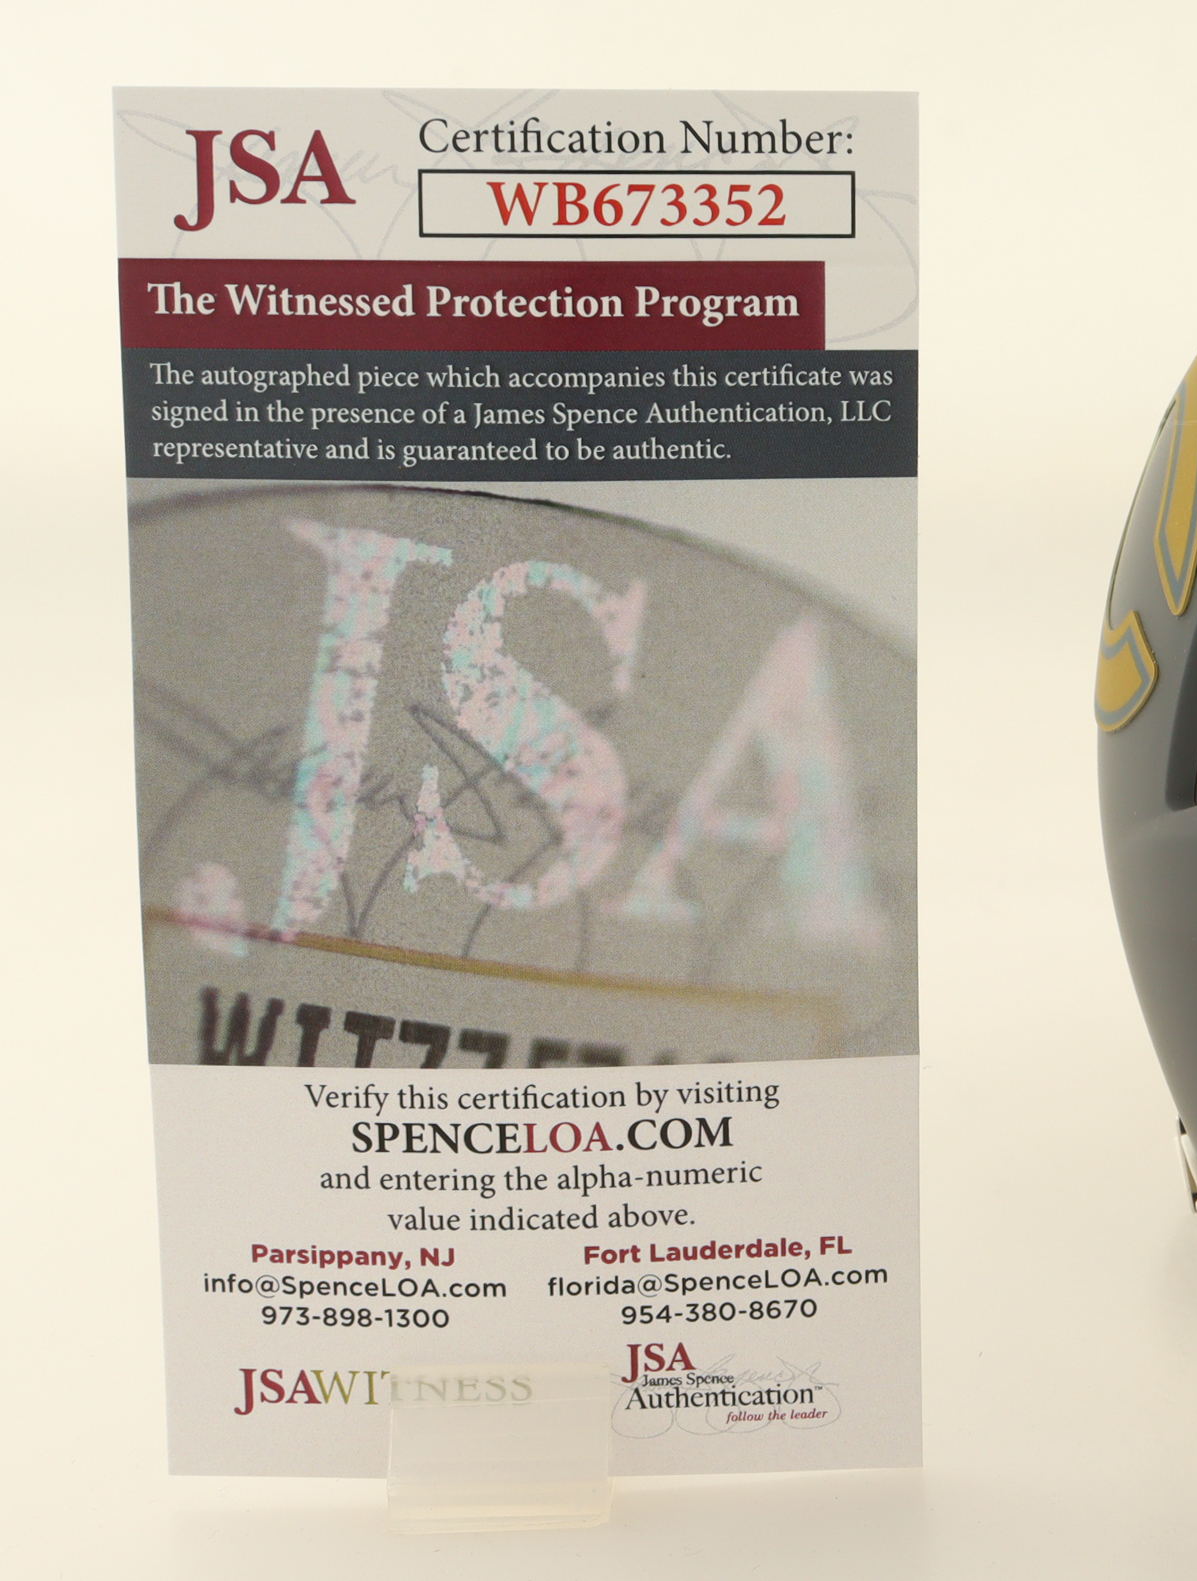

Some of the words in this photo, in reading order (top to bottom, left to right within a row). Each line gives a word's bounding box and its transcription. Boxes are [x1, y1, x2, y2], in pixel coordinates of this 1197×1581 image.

[419, 117, 666, 153] Certification
[680, 119, 855, 154] Number:
[174, 129, 356, 231] JSA
[486, 182, 786, 226] WB673352
[147, 282, 215, 315] The
[224, 284, 415, 316] Witnessed
[426, 286, 624, 317] Protection
[635, 286, 799, 327] Program
[150, 362, 194, 385] The
[201, 364, 350, 393] autographed
[358, 366, 419, 394] piece
[426, 365, 500, 387] which
[509, 366, 665, 394] accompanies
[673, 364, 717, 387] this
[725, 363, 841, 386] certificate
[849, 371, 893, 385] was
[152, 399, 228, 428] signed
[236, 401, 260, 422] in
[266, 400, 304, 422] the
[311, 408, 415, 430] presence
[422, 401, 449, 424] of
[454, 409, 466, 424] a
[474, 403, 545, 428] James
[553, 402, 638, 431] Spence
[645, 401, 832, 425] Authentication,
[841, 400, 891, 421] LLC
[153, 438, 318, 464] representative
[326, 437, 370, 459] and
[377, 439, 395, 460] is
[403, 438, 538, 467] guaranteed
[545, 442, 569, 460] to
[577, 438, 605, 460] be
[613, 437, 731, 459] authentic.
[172, 519, 891, 959] JSA
[304, 1084, 389, 1116] Verify
[397, 1085, 448, 1109] this
[458, 1084, 626, 1109] certification
[635, 1082, 669, 1113] by
[677, 1081, 779, 1108] visiting
[353, 1117, 733, 1154] SPENCELOA.COM
[321, 1165, 370, 1189] and
[380, 1169, 495, 1199] entering
[504, 1166, 547, 1191] the
[558, 1161, 762, 1197] alpha-numeric
[388, 1206, 460, 1231] value
[470, 1205, 598, 1231] indicated
[609, 1203, 695, 1228] above.
[252, 1244, 411, 1270] Parsippany,
[420, 1248, 454, 1266] NJ
[584, 1245, 641, 1265] Fort
[650, 1238, 810, 1262] Lauderdale,
[820, 1236, 852, 1255] FL
[204, 1273, 506, 1299] info@SpenceLOA.com
[548, 1263, 887, 1297] florida@SpenceLOA.com
[262, 1306, 449, 1328] 973-898-1300
[622, 1296, 817, 1325] 954-380-8670
[621, 1342, 697, 1383] JSA
[642, 1374, 683, 1387] James
[686, 1372, 735, 1387] Spence
[726, 1411, 764, 1424] follow
[768, 1409, 786, 1421] the
[790, 1409, 829, 1420] leader
